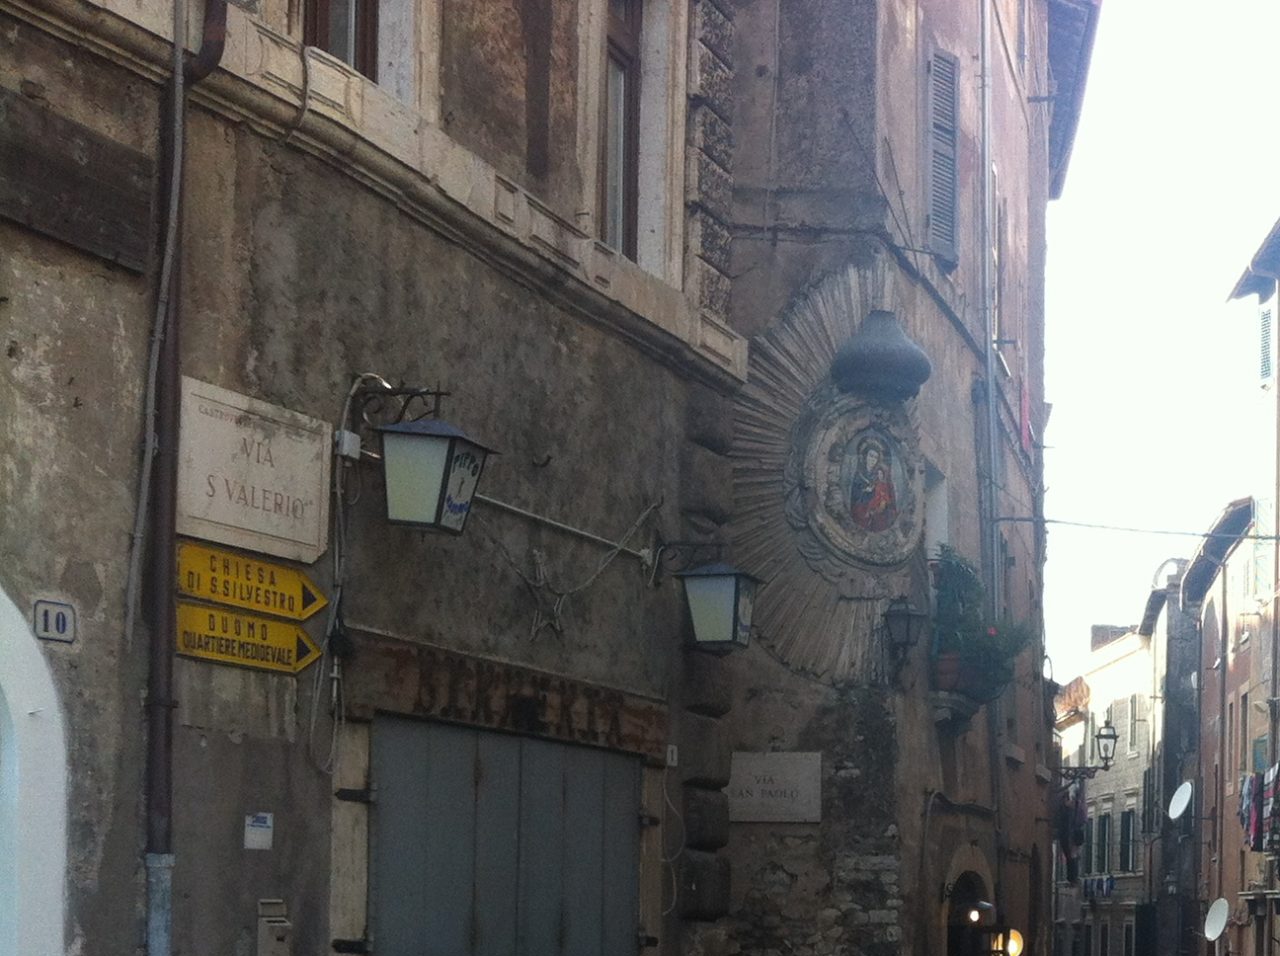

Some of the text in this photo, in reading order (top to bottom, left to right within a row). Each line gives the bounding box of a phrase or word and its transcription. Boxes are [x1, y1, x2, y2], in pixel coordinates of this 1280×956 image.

[242, 437, 275, 468] VIA
[224, 478, 305, 519] VALERIO
[187, 570, 201, 592] DI
[209, 554, 277, 586] CHIESA
[43, 609, 66, 634] 10
[208, 613, 268, 641] DUOMO
[183, 630, 293, 666] QUARTIERE MEDIOEVALE
[753, 775, 775, 785] VIA
